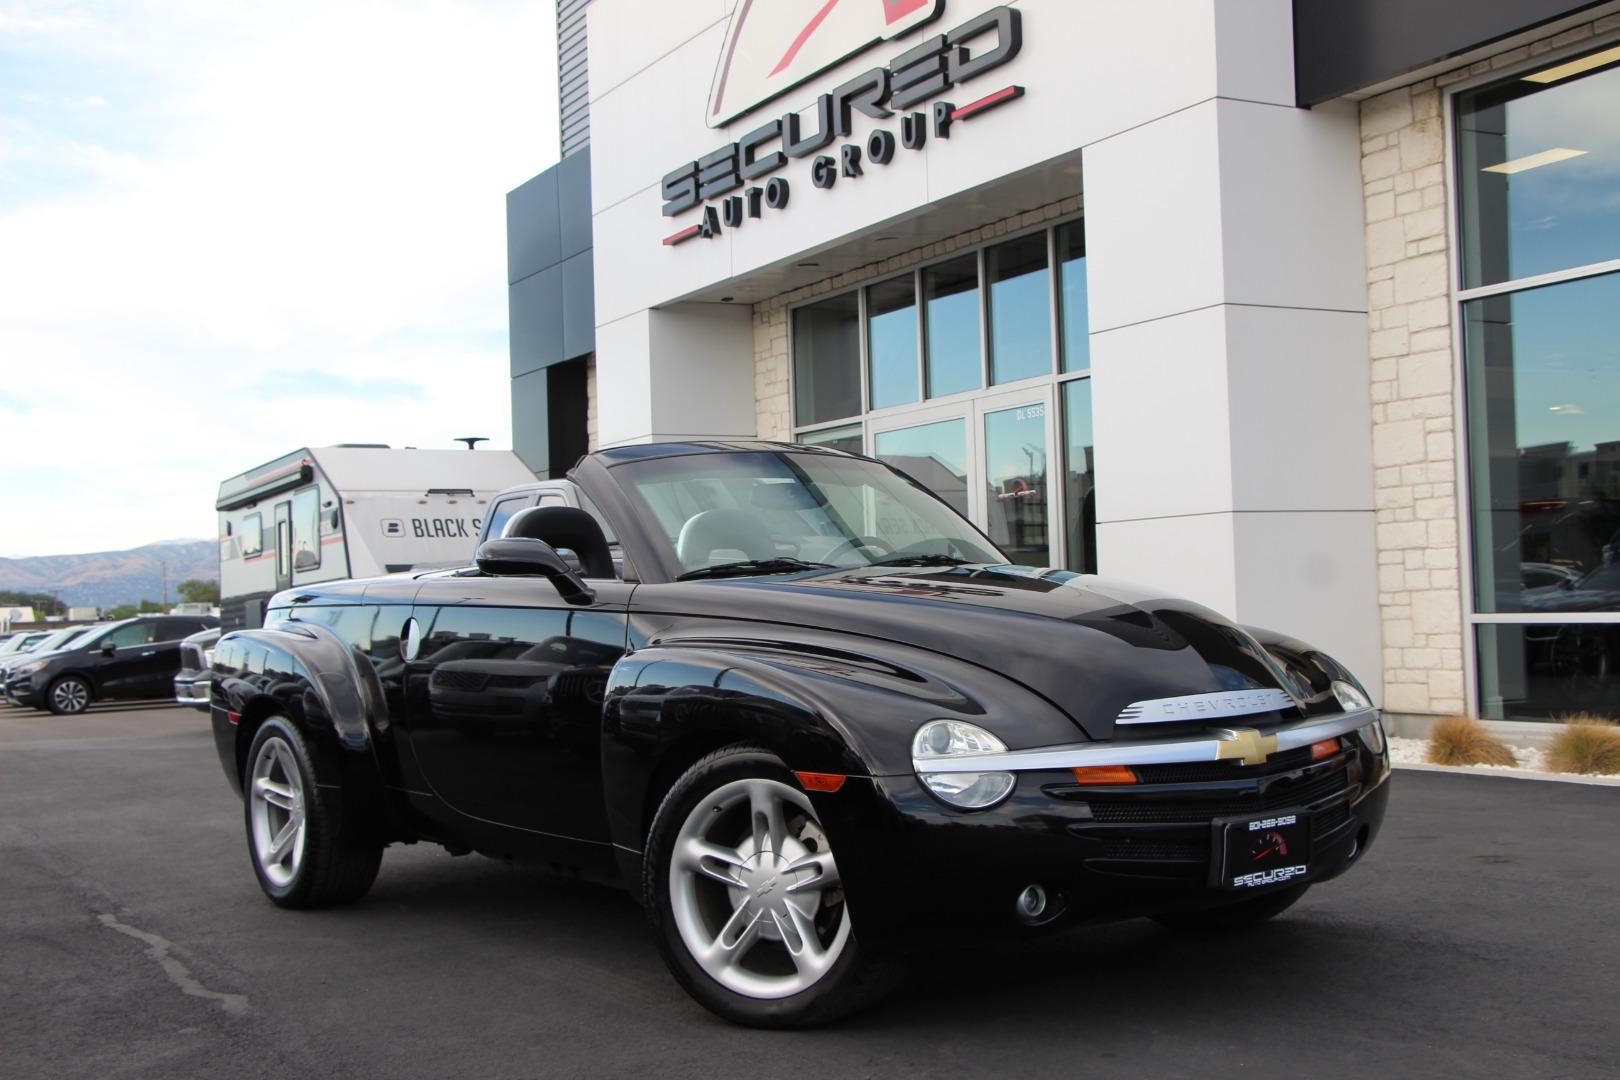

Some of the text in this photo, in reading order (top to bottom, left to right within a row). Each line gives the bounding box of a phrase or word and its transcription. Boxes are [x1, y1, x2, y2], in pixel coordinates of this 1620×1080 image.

[661, 5, 1023, 217] SECURED
[701, 101, 956, 239] AUTO GROUP
[411, 518, 469, 538] BLACK
[1162, 693, 1272, 714] CHEVROLET
[1233, 865, 1307, 887] SECURED
